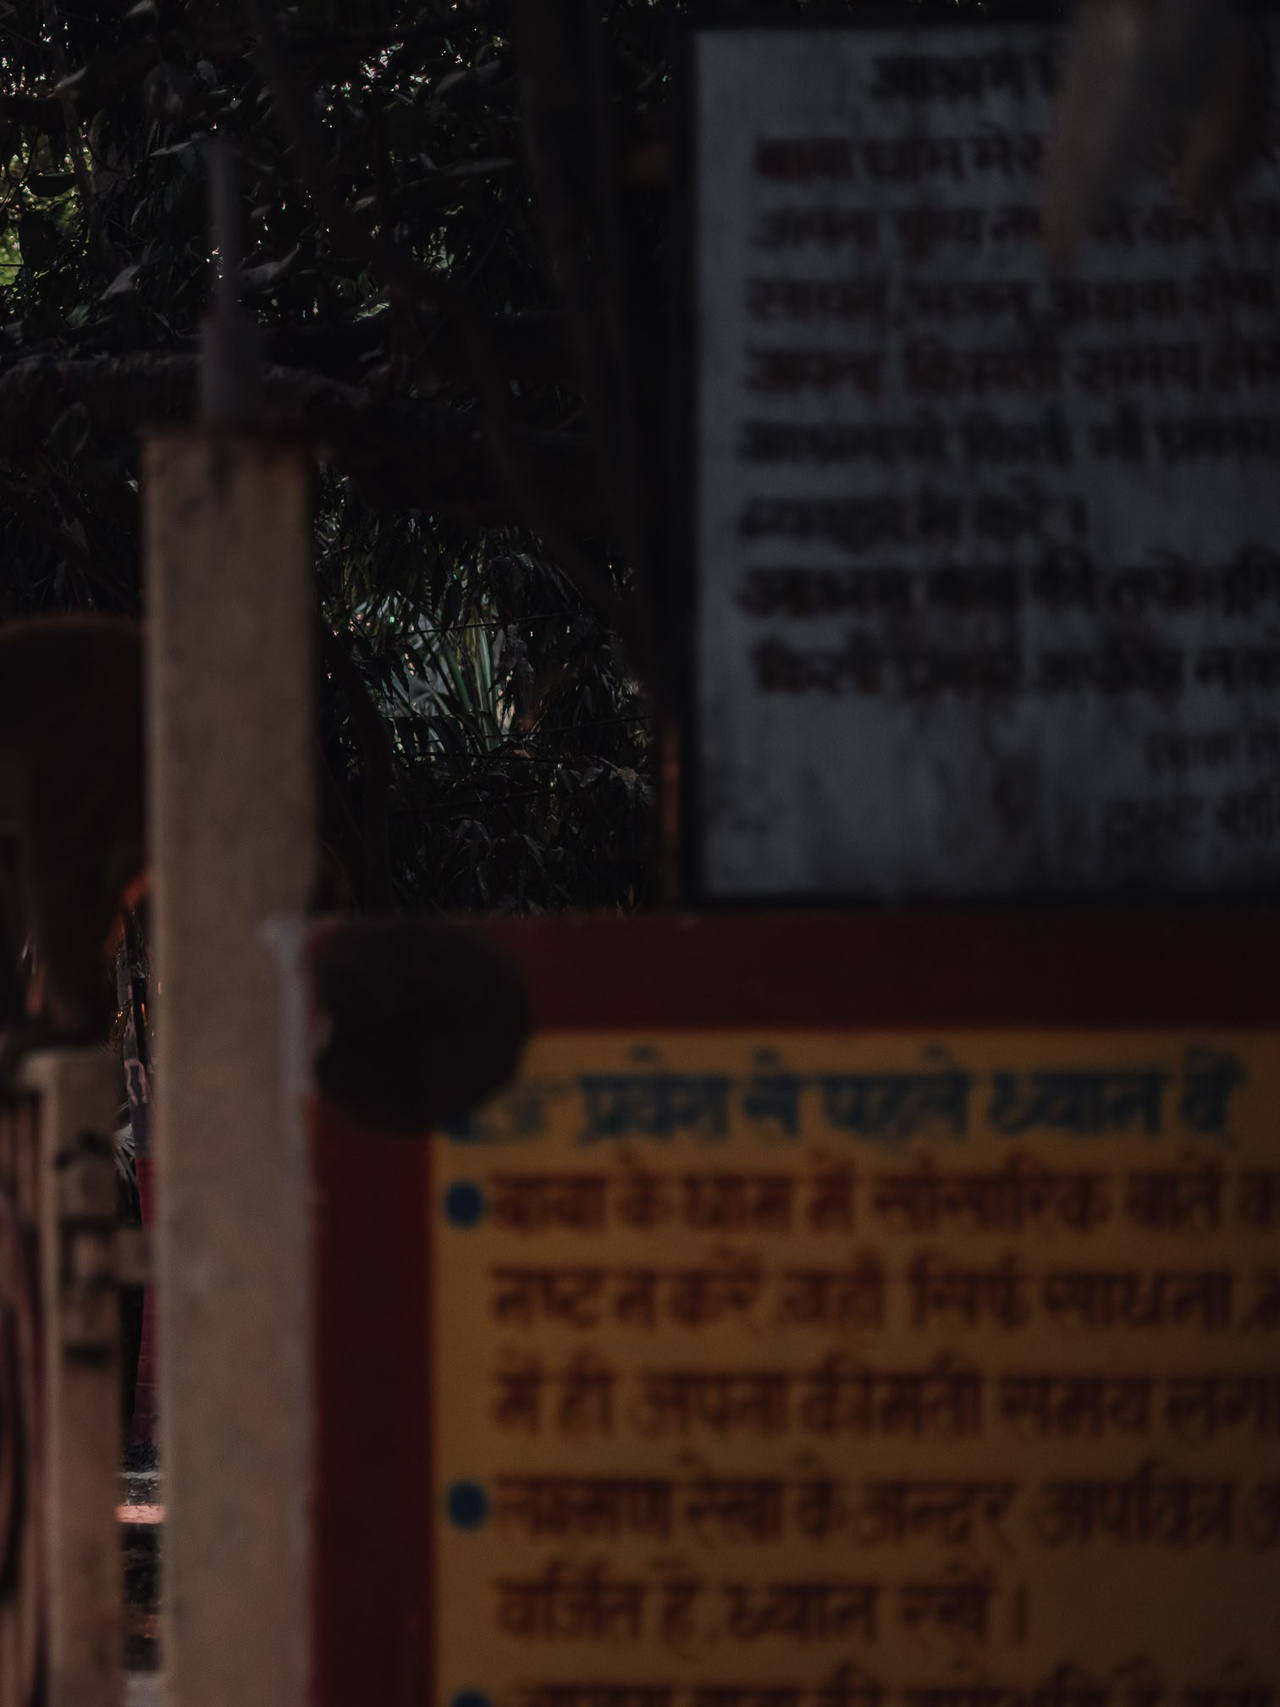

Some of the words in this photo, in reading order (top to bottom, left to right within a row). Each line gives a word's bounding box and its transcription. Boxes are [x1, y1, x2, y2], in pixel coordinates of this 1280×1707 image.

[990, 1069, 1167, 1140] ध्यान
[488, 1174, 605, 1230] बाबा
[617, 1150, 678, 1228] के
[685, 1172, 793, 1231] धाम
[489, 1267, 608, 1330] नष्ट
[616, 1268, 658, 1328] न
[558, 1348, 613, 1440] ही
[633, 1372, 788, 1440] अपना
[800, 1350, 983, 1438] कीमती
[999, 1373, 1151, 1438] समय
[796, 1453, 846, 1541] के
[1035, 1457, 1234, 1547] अपवित्र
[495, 1556, 643, 1645] वर्जित
